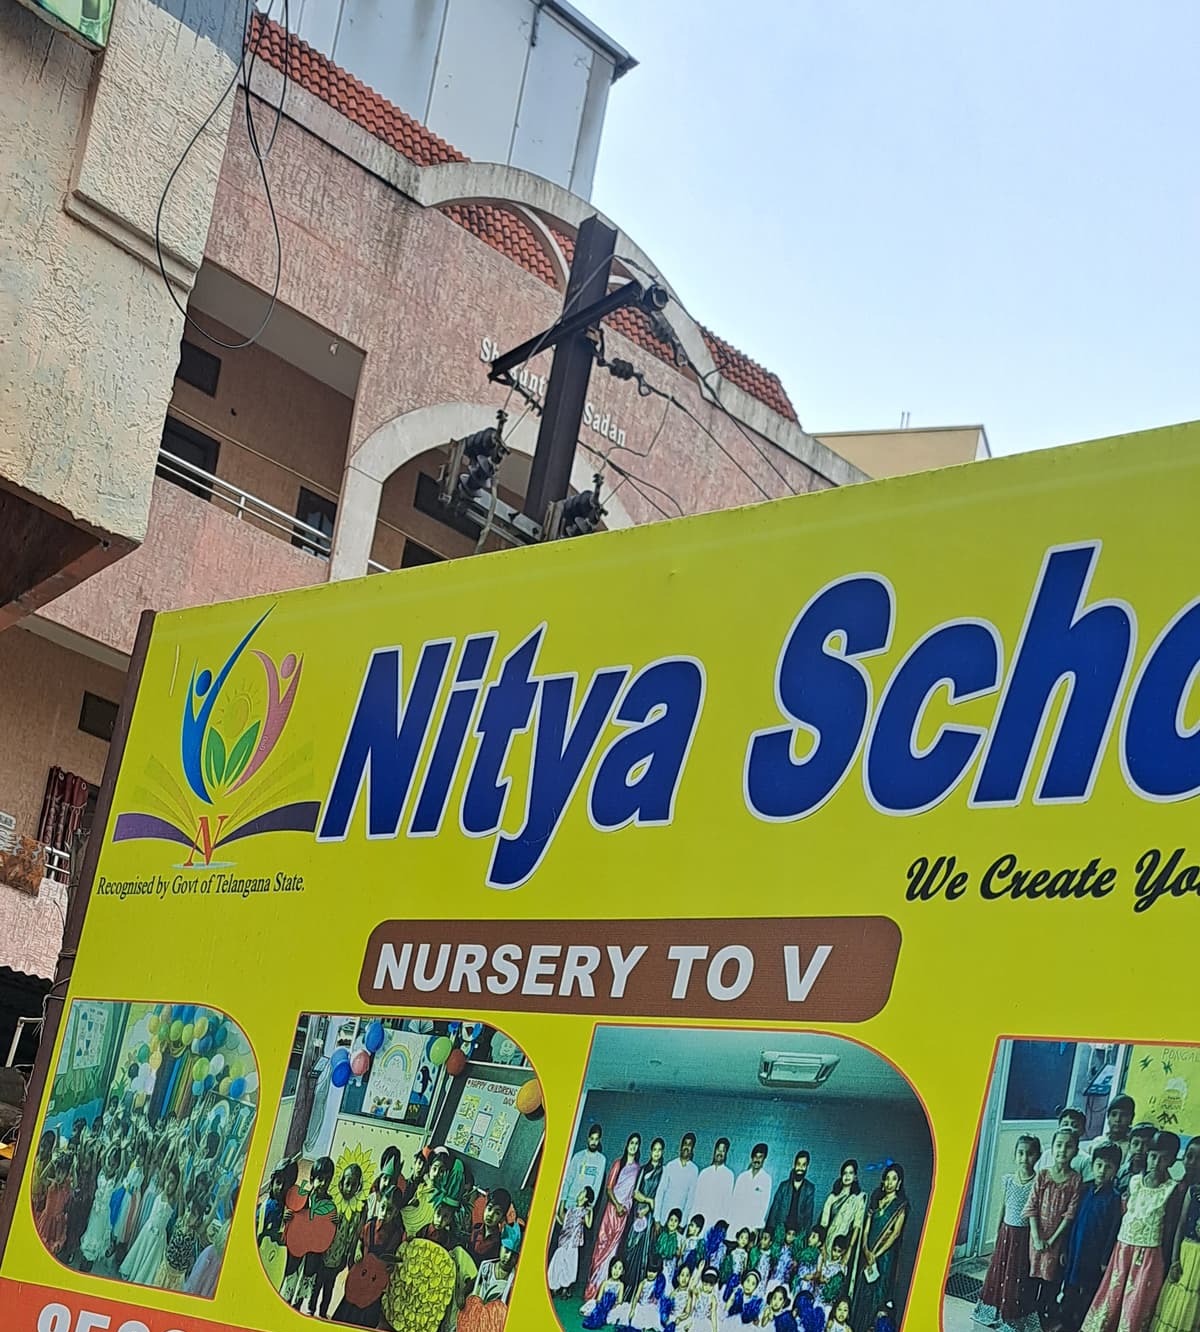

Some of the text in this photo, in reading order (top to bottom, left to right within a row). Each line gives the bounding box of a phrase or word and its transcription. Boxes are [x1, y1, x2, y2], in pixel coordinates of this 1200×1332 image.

[583, 403, 626, 446] Sadan
[315, 622, 706, 890] Nitya
[96, 872, 305, 899] Recognised by Govt of Telangana State.
[906, 847, 1200, 913] We Create Yo
[373, 943, 833, 1002] NURSERY TO V
